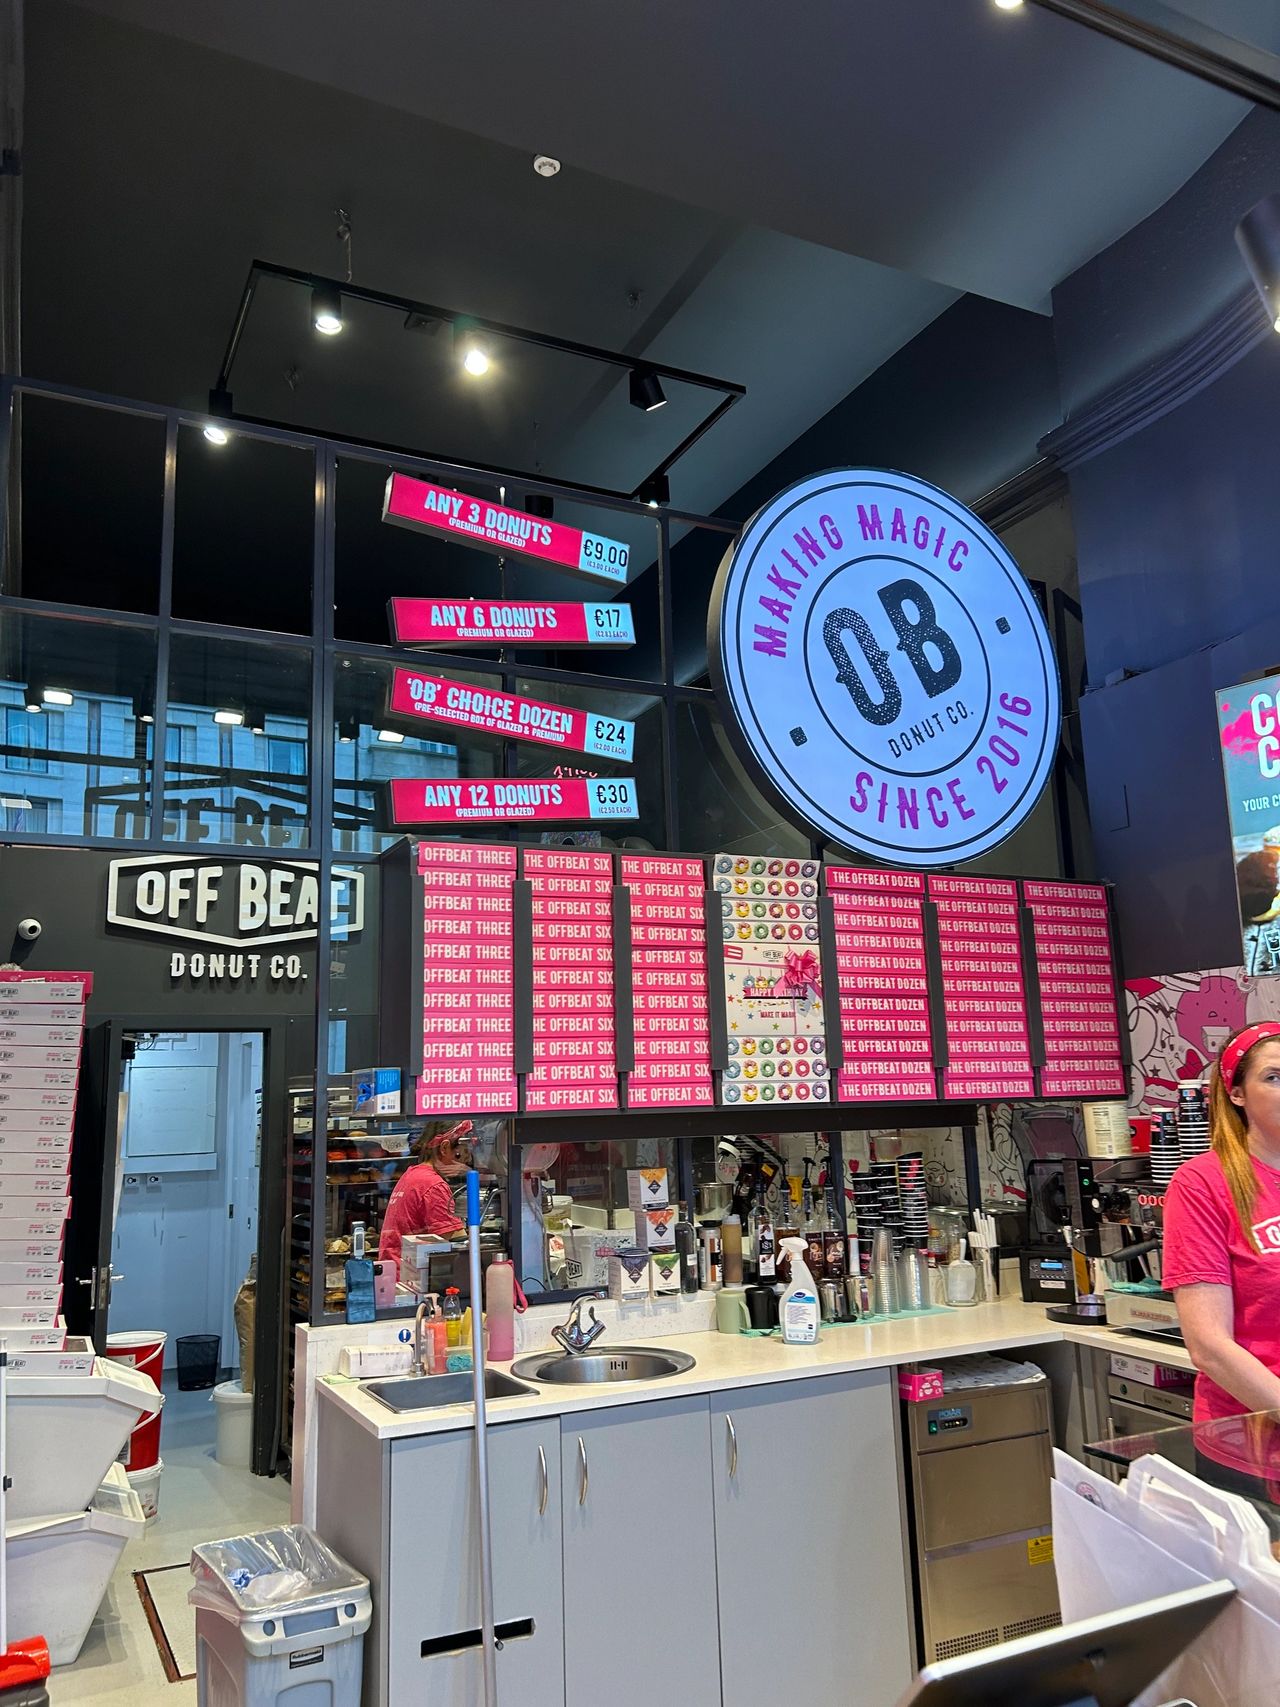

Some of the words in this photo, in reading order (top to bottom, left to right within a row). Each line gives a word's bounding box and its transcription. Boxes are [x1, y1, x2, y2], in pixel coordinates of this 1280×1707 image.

[424, 490, 463, 518] ANY
[468, 502, 480, 523] 3
[485, 508, 552, 545] DONUTS
[449, 516, 485, 536] (PREMIUM
[486, 528, 497, 539] OR
[498, 530, 526, 548] GLAZED)
[583, 539, 628, 567] €9.00
[753, 513, 844, 658] MAKING
[856, 504, 969, 572] MAGIC
[431, 605, 467, 627] ANY
[473, 606, 485, 627] 6
[490, 607, 557, 628] DONUTS
[594, 608, 620, 628] €17
[456, 627, 493, 637] (PREMIUM
[494, 628, 504, 637] OR
[505, 627, 534, 638] GLAZED)
[822, 578, 962, 726] OB
[446, 687, 514, 721] CHOICE
[519, 703, 573, 734] DOZEN
[414, 702, 469, 722] (PRE-SELECTED
[470, 713, 485, 726] BOX
[486, 717, 496, 728] OF
[497, 721, 522, 733] GLAZED
[523, 725, 530, 734] &
[532, 727, 565, 743] PREMIUM)
[887, 711, 943, 758] DONUT
[947, 699, 974, 726] CO.
[594, 720, 625, 744] €24
[849, 771, 976, 830] SINCE
[976, 691, 1032, 795] 2016
[425, 785, 462, 807] ANY
[468, 785, 488, 807] 12
[494, 784, 563, 806] DONUTS
[596, 784, 628, 804] €30
[1243, 796, 1270, 812] YOUR
[455, 807, 493, 817] (PREMIUM
[494, 807, 505, 817] OR
[506, 807, 535, 817] GLAZED)
[424, 847, 473, 863] OFFBEAT
[476, 850, 512, 864] THREE
[524, 854, 544, 868] THE
[547, 856, 590, 869] OFFBEAT
[594, 858, 609, 870] SIX
[621, 860, 640, 873] THE
[643, 862, 682, 875] OFFBEAT
[686, 864, 701, 876] SIX
[424, 871, 472, 886] OFFBEAT
[476, 874, 511, 888] THREE
[833, 872, 851, 883] THE
[852, 873, 889, 885] OFFBEAT
[891, 876, 920, 887] DOZEN
[932, 880, 948, 891] THE
[950, 881, 984, 893] OFFBEAT
[986, 884, 1012, 895] DOZEN
[1028, 885, 1043, 896] THE
[1044, 887, 1076, 898] OFFBEAT
[1078, 889, 1102, 899] DOZEN
[136, 865, 224, 923] OFF
[239, 863, 345, 931] BEAT
[424, 896, 472, 910] OFFBEAT
[476, 897, 512, 911] THREE
[1031, 905, 1046, 916] THE
[1047, 906, 1079, 917] OFFBEAT
[1081, 908, 1105, 918] DOZEN
[424, 920, 472, 934] OFFBEAT
[476, 921, 511, 935] THREE
[836, 934, 852, 946] THE
[853, 935, 891, 947] OFFBEAT
[893, 937, 922, 949] DOZEN
[424, 944, 472, 958] OFFBEAT
[476, 945, 510, 959] THREE
[533, 947, 546, 960] HE
[550, 947, 593, 961] OFFBEAT
[597, 948, 612, 961] SIX
[170, 953, 261, 978] DONUT
[269, 954, 308, 979] CO.
[942, 960, 953, 971] HE
[954, 961, 989, 972] OFFBEAT
[991, 962, 1017, 972] DOZEN
[424, 968, 472, 983] OFFBEAT
[476, 970, 511, 983] THREE
[838, 976, 856, 988] THE
[857, 977, 895, 988] OFFBEAT
[897, 978, 926, 989] DOZEN
[424, 993, 472, 1007] OFFBEAT
[476, 994, 511, 1007] THREE
[633, 995, 645, 1008] HE
[648, 996, 688, 1008] OFFBEAT
[692, 996, 707, 1008] SIX
[424, 1018, 472, 1032] OFFBEAT
[476, 1018, 511, 1032] THREE
[533, 1018, 546, 1032] HE
[550, 1018, 594, 1031] OFFBEAT
[598, 1018, 614, 1031] SIX
[947, 1021, 958, 1032] HE
[960, 1021, 995, 1032] OFFBEAT
[997, 1021, 1024, 1032] DOZEN
[1043, 1021, 1055, 1032] HE
[1055, 1021, 1088, 1032] OFFBEAT
[1089, 1021, 1114, 1032] DOZEN
[424, 1043, 473, 1058] OFFBEAT
[477, 1042, 513, 1057] THREE
[634, 1041, 646, 1055] HE
[650, 1041, 690, 1054] OFFBEAT
[694, 1041, 709, 1054] SIX
[422, 1068, 472, 1083] OFFBEAT
[476, 1067, 512, 1082] THREE
[842, 1084, 861, 1096] THE
[862, 1084, 900, 1096] OFFBEAT
[902, 1083, 931, 1095] DOZEN
[948, 1082, 965, 1094] THE
[965, 1082, 1001, 1094] OFFBEAT
[1002, 1081, 1030, 1093] DOZEN
[1045, 1081, 1061, 1092] THE
[1061, 1080, 1094, 1091] OFFBEAT
[1096, 1080, 1121, 1090] DOZEN
[422, 1093, 472, 1109] OFFBEAT
[476, 1092, 512, 1107] THREE
[526, 1091, 546, 1105] THE
[550, 1090, 594, 1104] OFFBEAT
[598, 1089, 615, 1103] SIX
[628, 1088, 647, 1102] THE
[651, 1088, 692, 1101] OFFBEAT
[695, 1087, 711, 1100] SIX
[1159, 1366, 1178, 1381] THE
